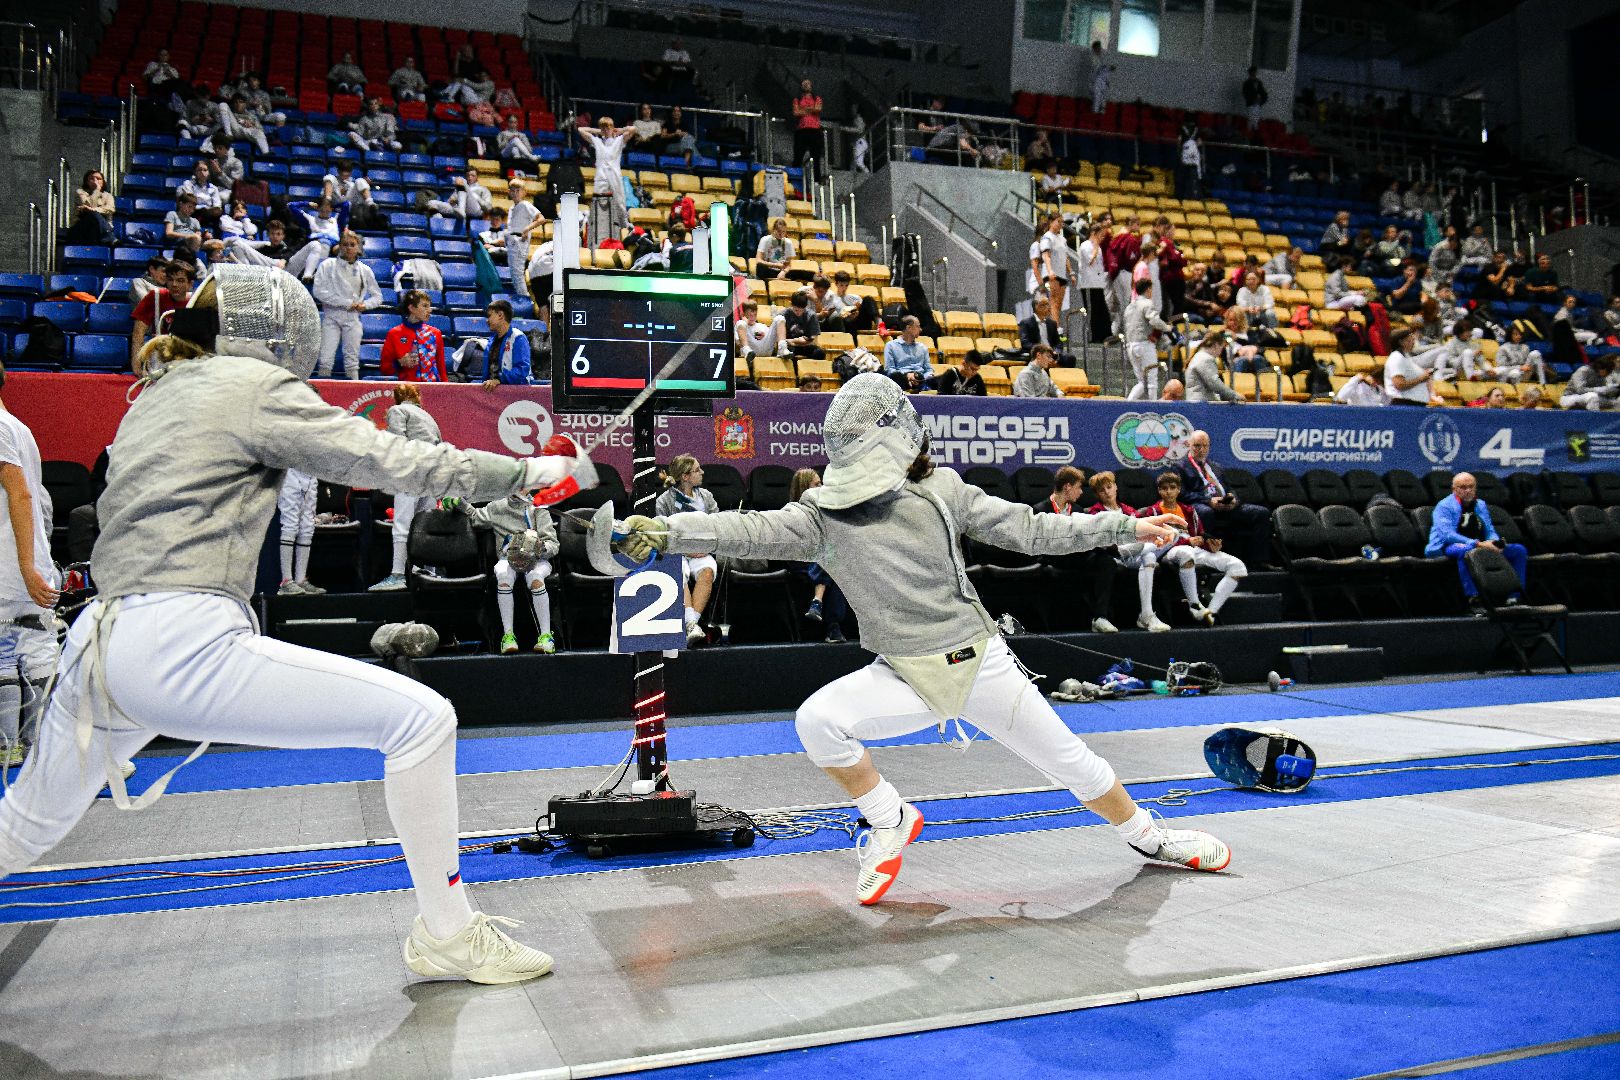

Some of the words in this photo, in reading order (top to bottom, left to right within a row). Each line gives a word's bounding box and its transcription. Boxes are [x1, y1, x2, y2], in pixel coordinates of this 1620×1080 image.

[646, 300, 652, 312] 1
[574, 313, 583, 324] 2
[714, 319, 723, 329] 2
[571, 344, 590, 375] 6
[709, 348, 727, 379] 7
[560, 413, 669, 428] ЗДОРОЕ
[922, 414, 1070, 440] МОСОБЛ
[560, 431, 671, 447] ТЕЧЕСО
[1274, 428, 1395, 451] ДИРЕКЦИЯ
[928, 440, 1040, 464] СПОРТ
[1263, 450, 1383, 463] СПОРТМЕРОПРИЯТИЙ
[618, 570, 684, 637] 2
